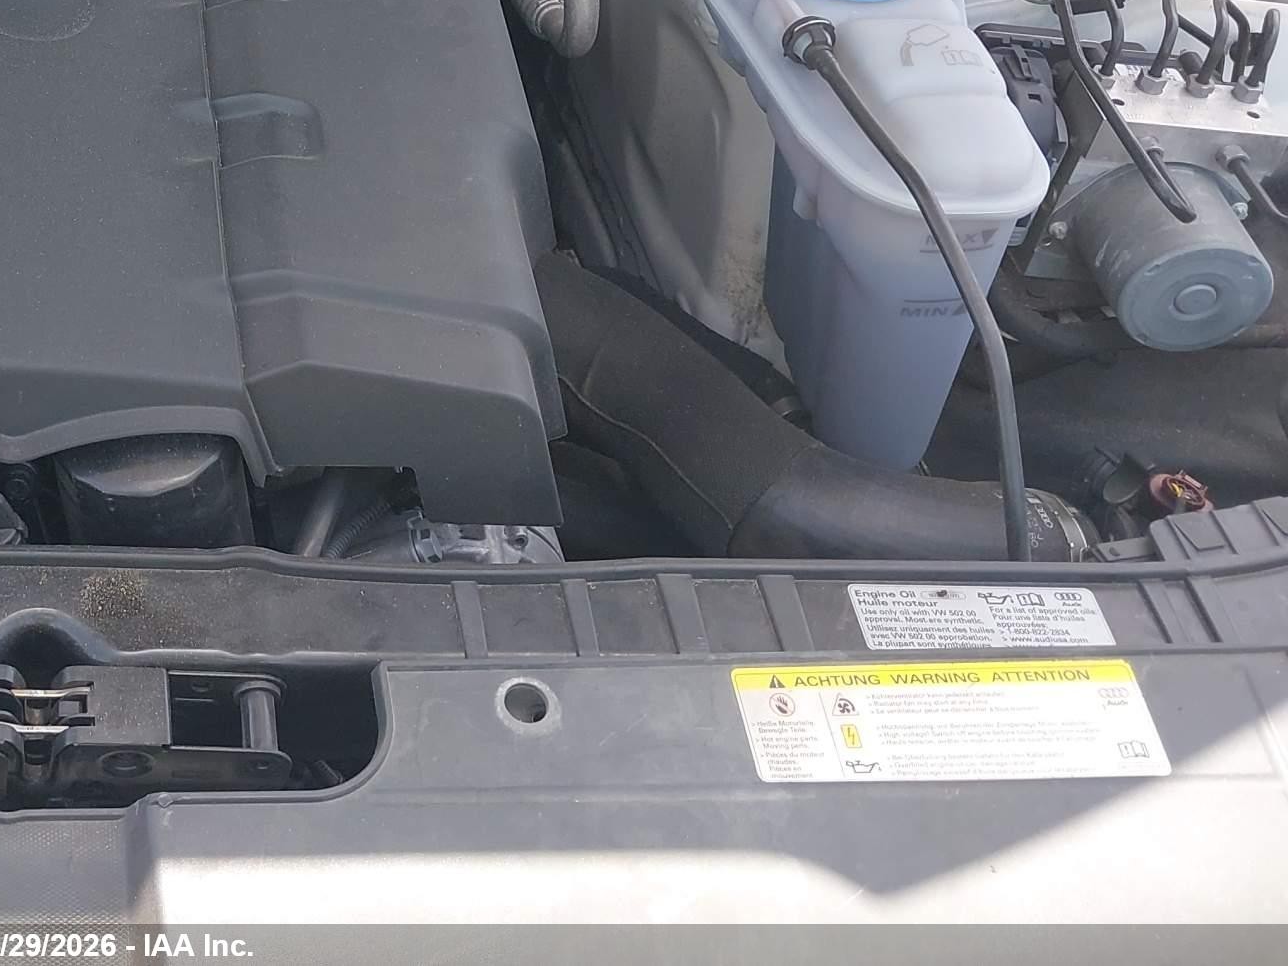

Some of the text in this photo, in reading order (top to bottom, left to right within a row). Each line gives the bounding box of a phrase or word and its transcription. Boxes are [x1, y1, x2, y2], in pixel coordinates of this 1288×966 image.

[899, 305, 949, 317] MIN
[854, 589, 896, 599] Engine
[899, 590, 917, 598] Oil
[856, 598, 939, 608] Huile moteur
[879, 608, 897, 616] only
[899, 608, 911, 616] oil
[911, 608, 930, 616] with
[989, 606, 1004, 614] For
[1038, 608, 1079, 616] approved
[992, 613, 1013, 621] Pour
[866, 624, 898, 632] Utilisez
[900, 625, 950, 634] uniquement
[952, 625, 968, 633] des
[891, 632, 907, 640] VW
[872, 639, 883, 647] La
[885, 640, 917, 649] plupart
[794, 669, 1091, 687] ACHTUNG WARNING ATTENTION
